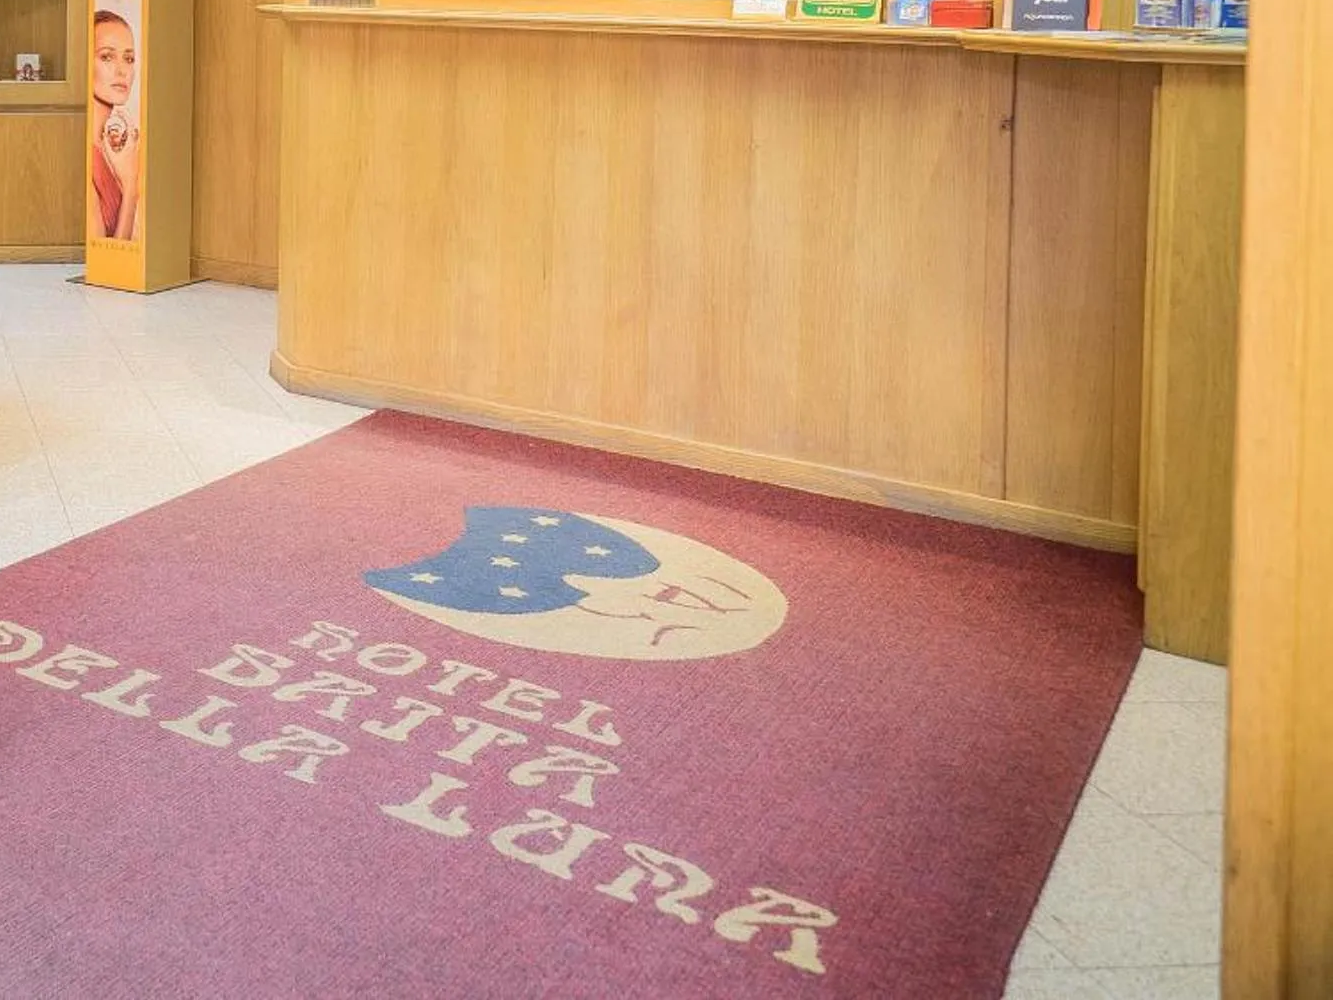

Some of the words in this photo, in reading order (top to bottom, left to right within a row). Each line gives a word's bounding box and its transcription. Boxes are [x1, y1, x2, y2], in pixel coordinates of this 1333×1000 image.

[816, 6, 858, 17] HOTEL
[290, 620, 622, 746] HOTEL
[377, 770, 841, 974] LUNA
